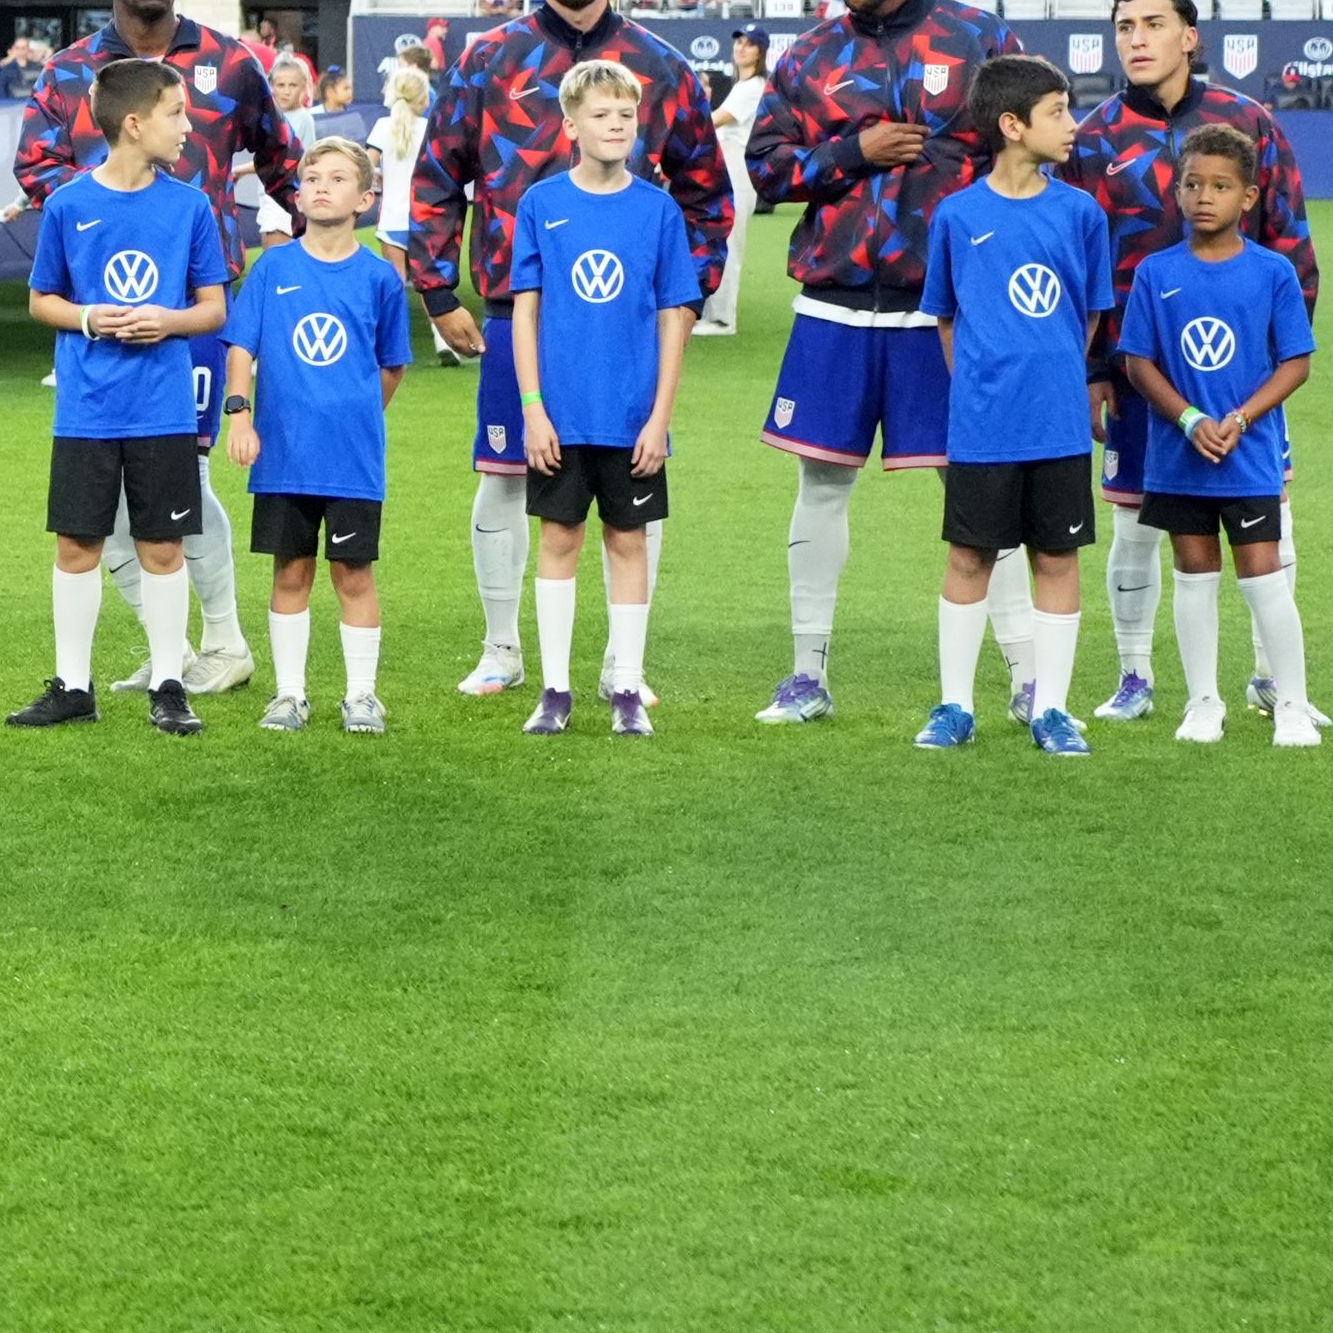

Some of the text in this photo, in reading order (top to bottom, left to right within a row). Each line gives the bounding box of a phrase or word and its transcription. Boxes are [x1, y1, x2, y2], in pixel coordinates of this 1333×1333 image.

[689, 59, 734, 76] lstate
[104, 250, 158, 303] VW
[572, 249, 624, 303] VW
[1009, 264, 1061, 318] VW
[292, 313, 347, 366] VW
[1181, 317, 1235, 371] VW
